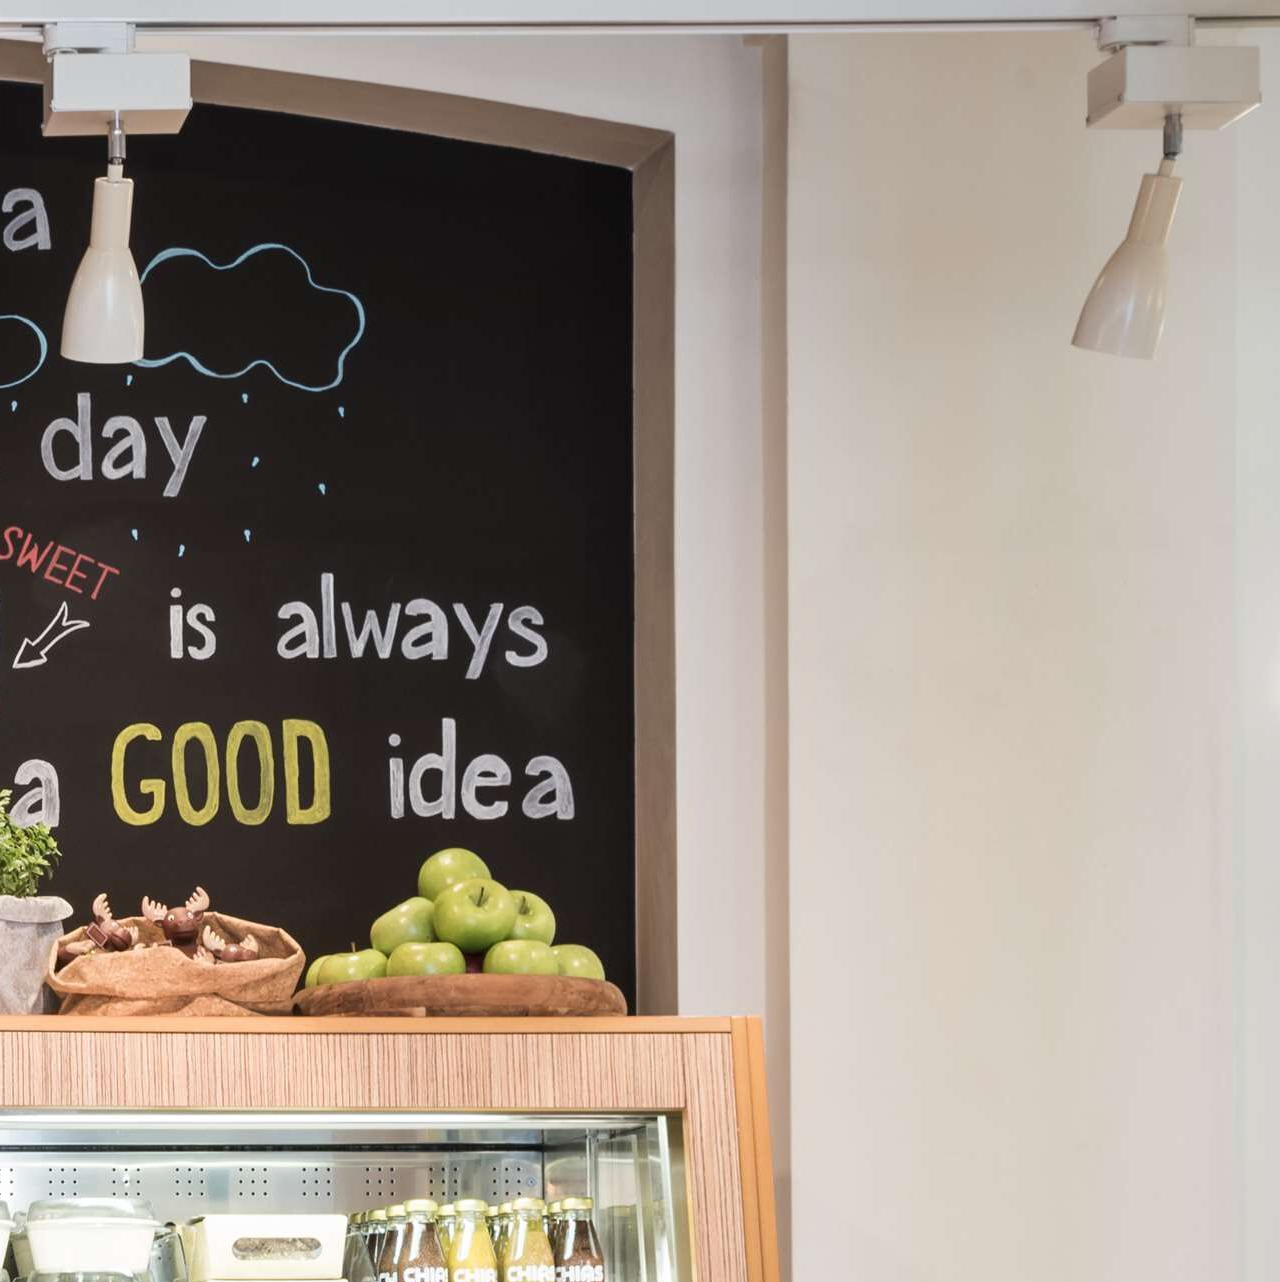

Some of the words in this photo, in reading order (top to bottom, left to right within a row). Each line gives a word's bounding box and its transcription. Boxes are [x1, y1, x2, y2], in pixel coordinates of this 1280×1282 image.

[1, 187, 52, 252] a
[40, 392, 208, 498] day
[169, 587, 217, 661] is
[277, 571, 549, 681] always
[11, 758, 61, 828] a
[110, 718, 331, 826] GOOD
[387, 717, 576, 820] idea
